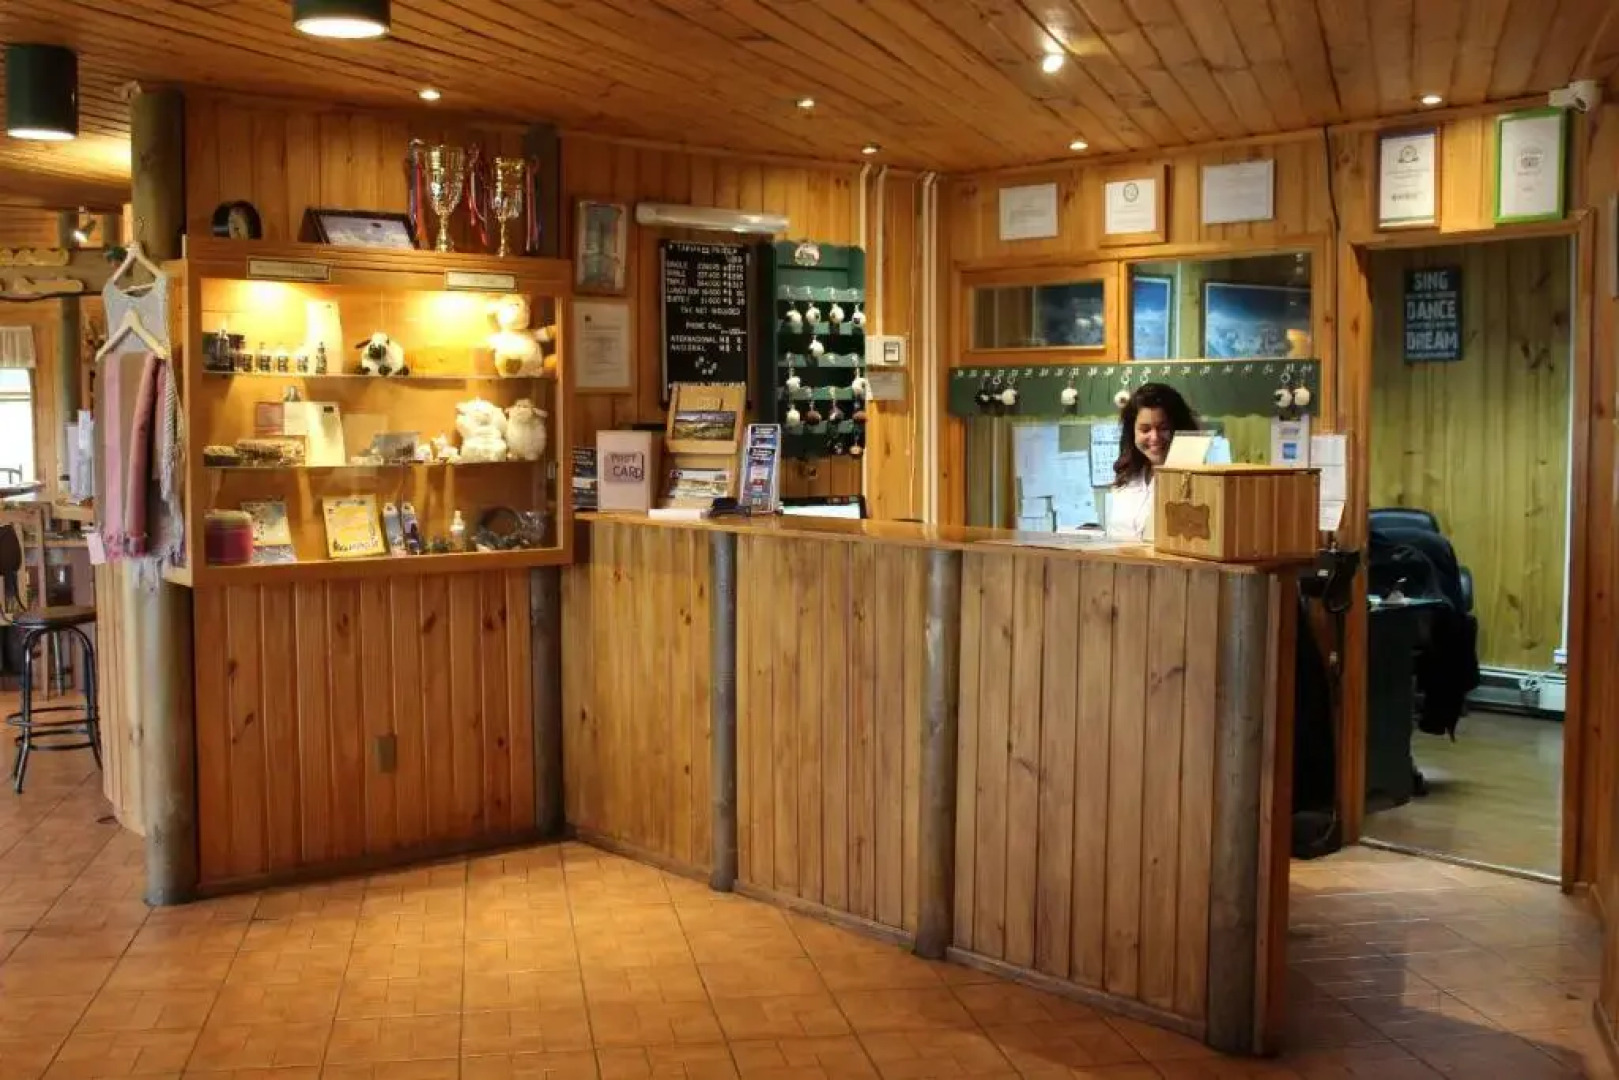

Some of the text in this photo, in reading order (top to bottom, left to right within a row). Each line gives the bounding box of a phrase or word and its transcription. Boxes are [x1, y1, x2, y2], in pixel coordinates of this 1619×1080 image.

[1414, 271, 1448, 290] SING
[1406, 301, 1456, 319] DANCE
[1406, 331, 1457, 350] DREAM
[613, 466, 642, 479] CARD
